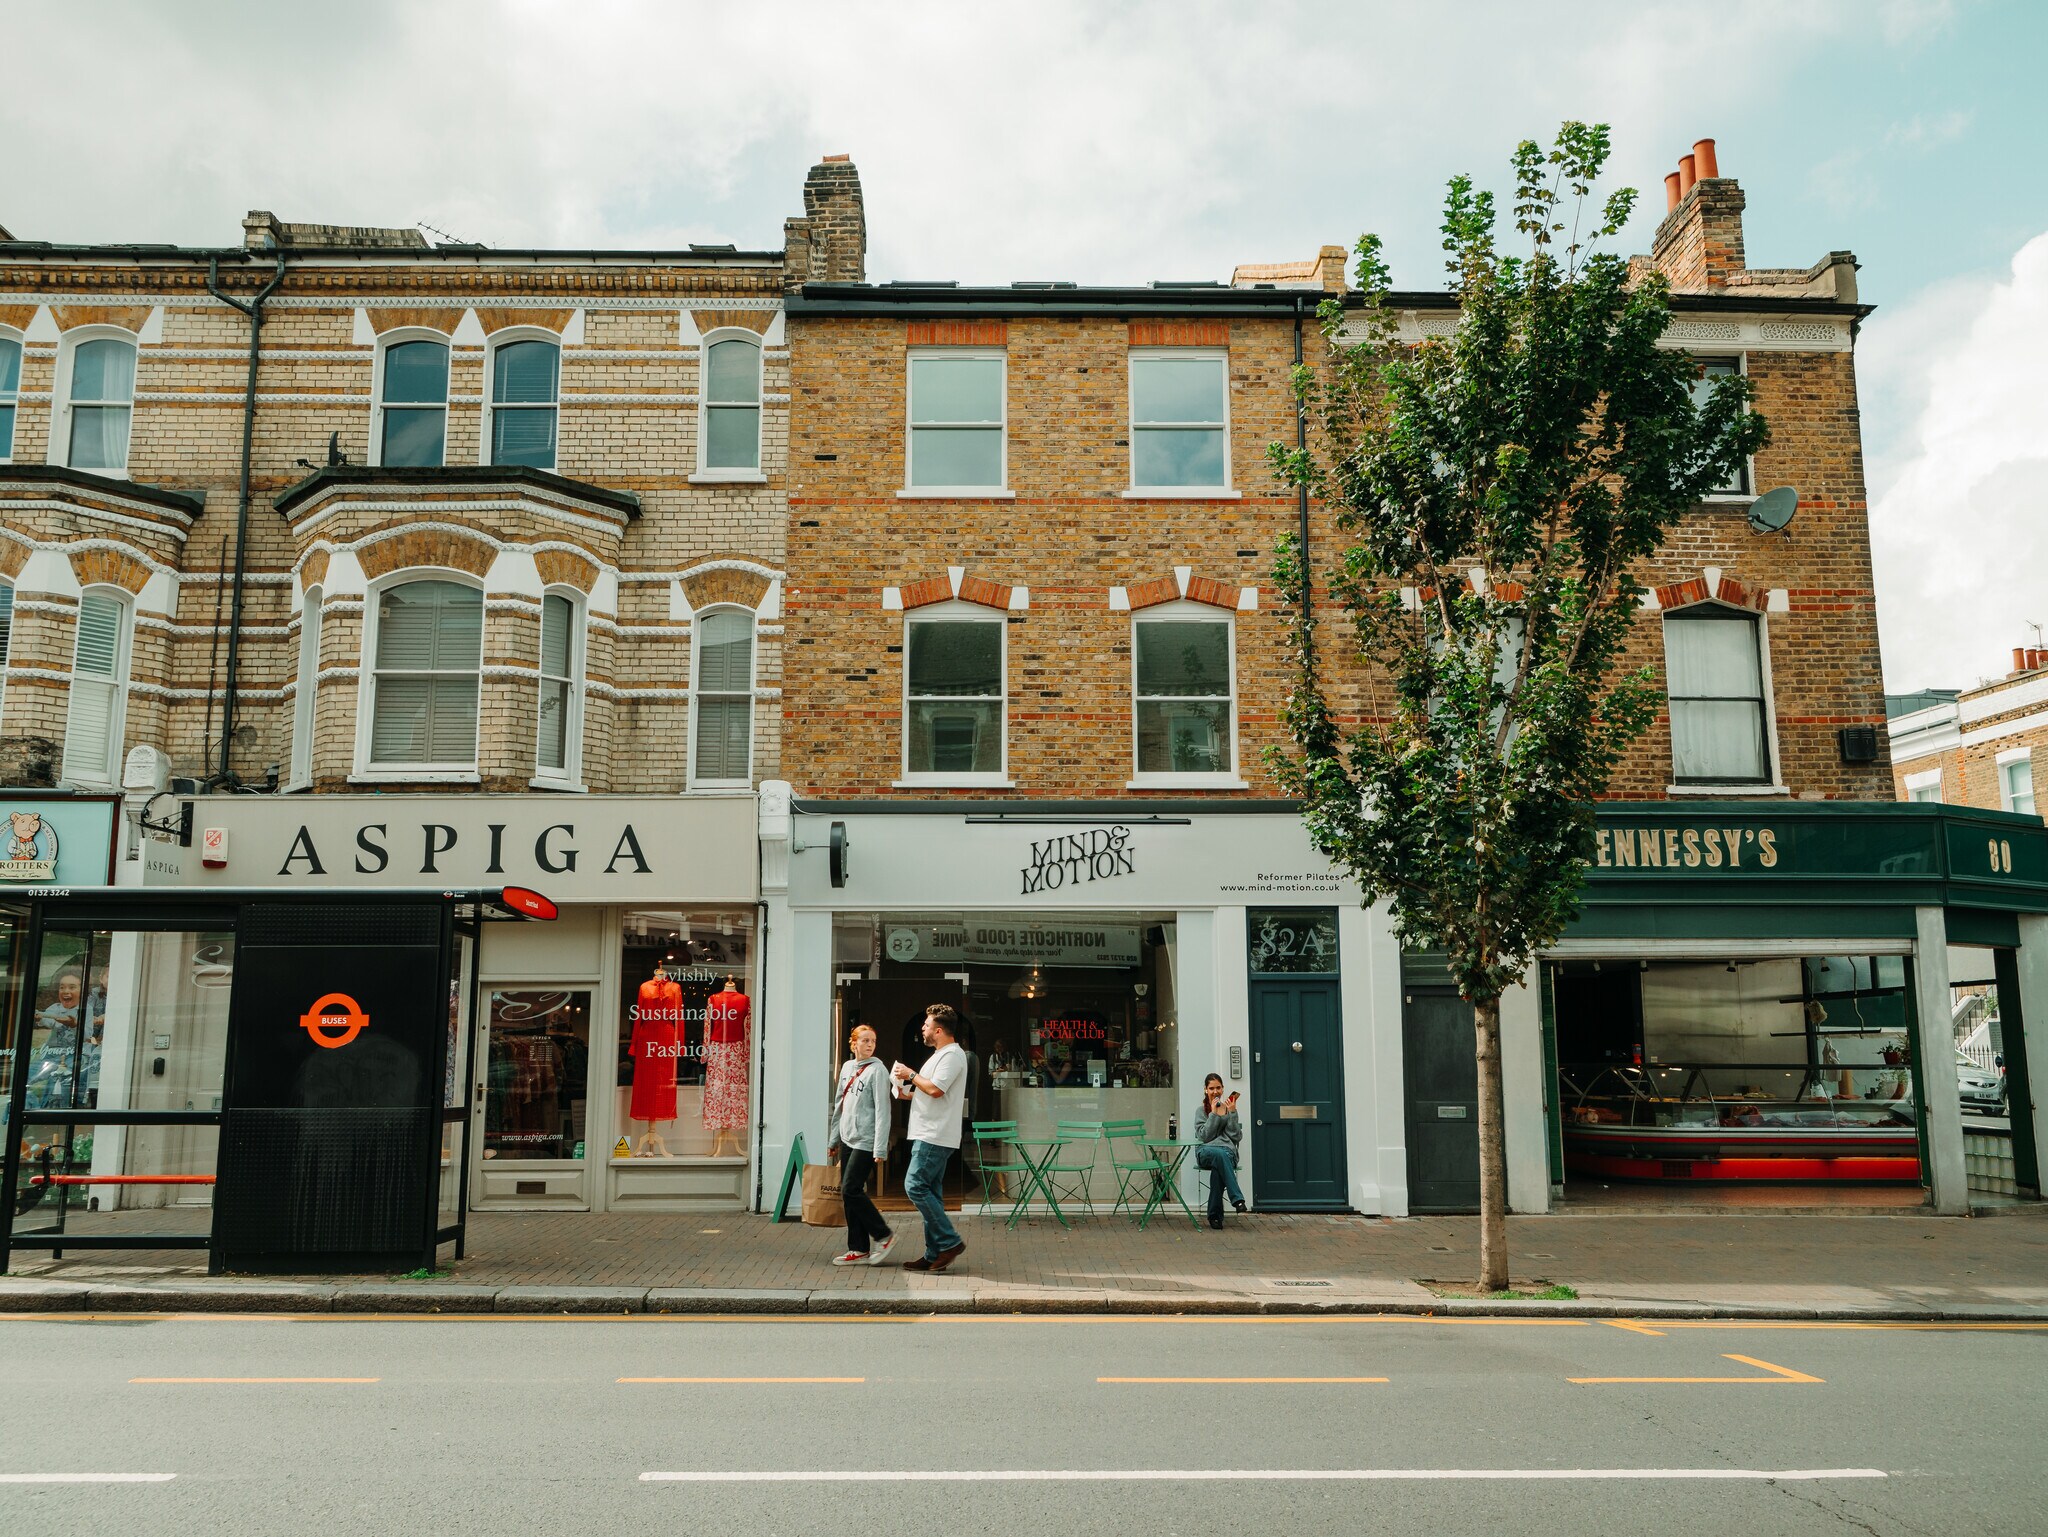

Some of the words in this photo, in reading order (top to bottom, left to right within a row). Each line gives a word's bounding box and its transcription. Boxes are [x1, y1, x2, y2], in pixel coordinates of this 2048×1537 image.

[277, 823, 654, 875] ASPIGA
[1588, 828, 1778, 867] ENNESSY'S
[1988, 838, 2012, 874] 80
[0, 861, 49, 870] ROTTERS
[146, 862, 180, 876] ASPIGA
[1020, 847, 1136, 895] MOTION
[1257, 873, 1303, 881] Reformer
[1306, 873, 1340, 881] Pilates
[1220, 883, 1340, 892] www.mind-motion.co.uk
[893, 938, 914, 951] 82
[1260, 927, 1325, 957] 82A
[653, 967, 718, 985] Stylishly
[628, 1003, 738, 1022] Sustainable
[1044, 1020, 1086, 1030] HEALTH
[1089, 1021, 1097, 1030] &
[1037, 1029, 1075, 1039] SOCIAL
[1075, 1029, 1105, 1039] CLUB
[645, 1040, 720, 1058] Fashion
[501, 1132, 564, 1143] www.aspiga.com
